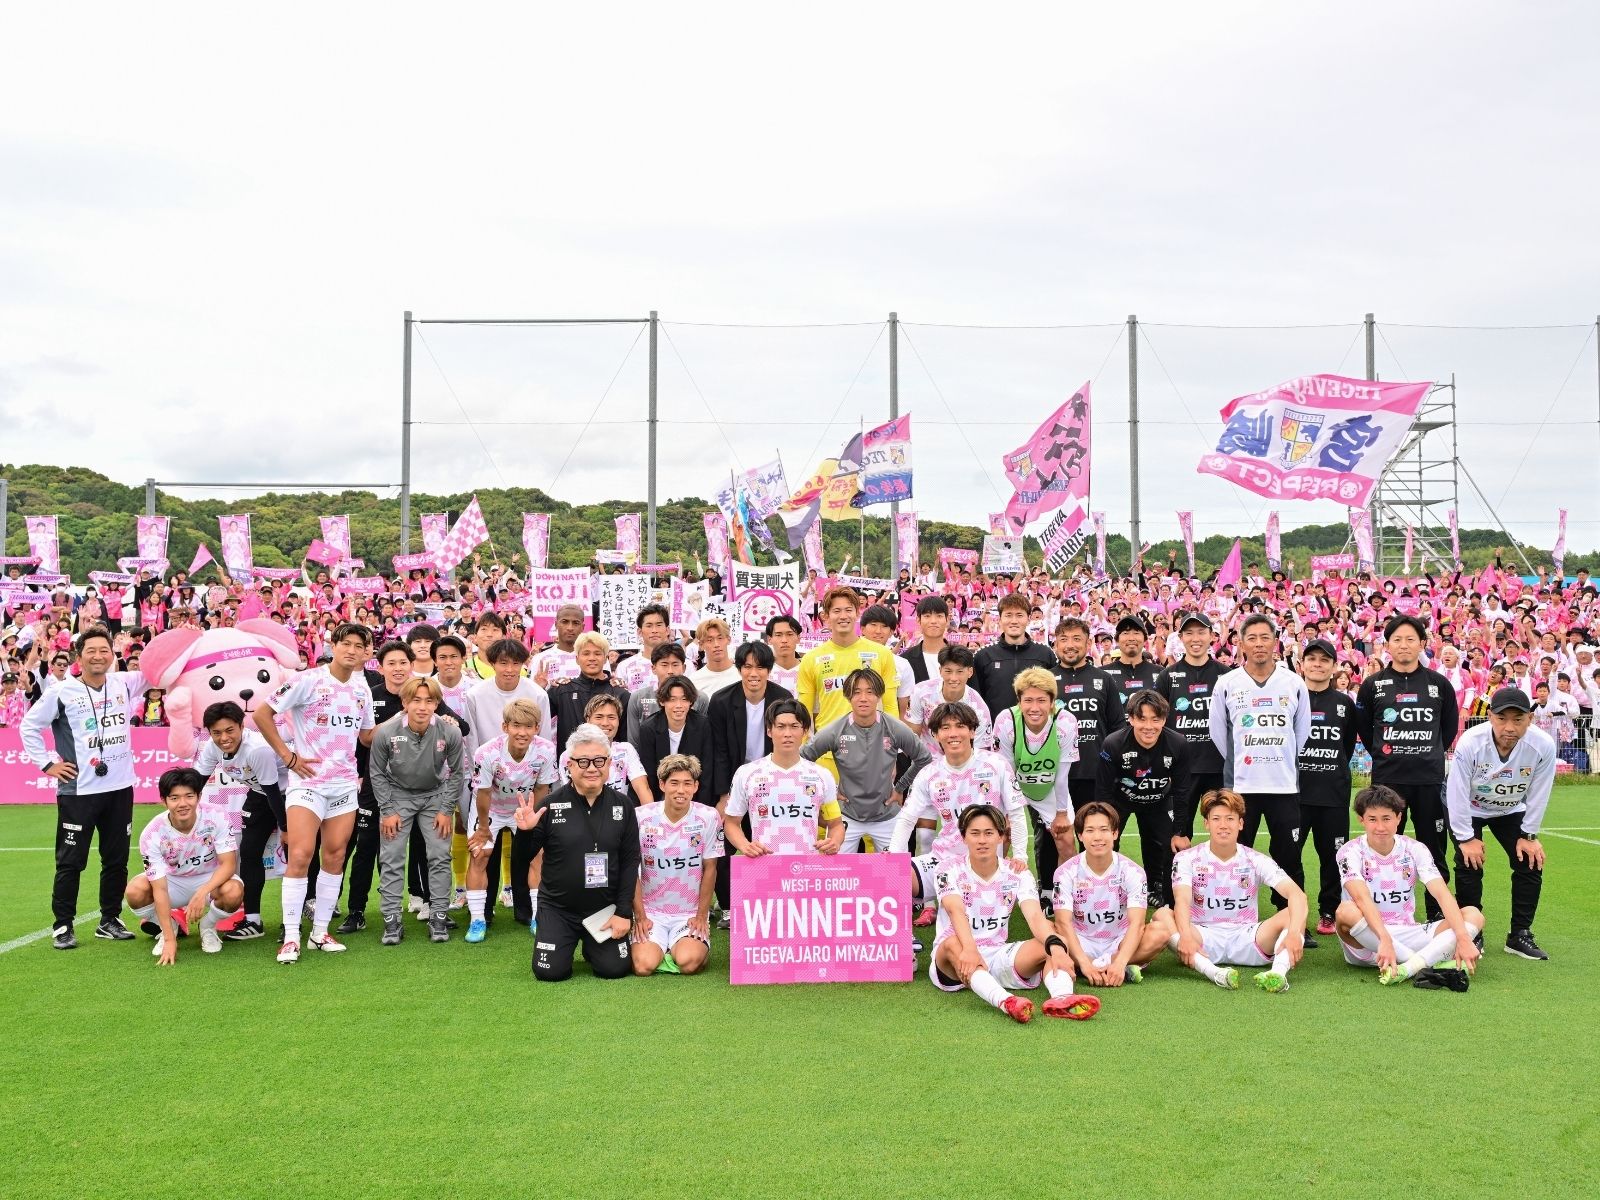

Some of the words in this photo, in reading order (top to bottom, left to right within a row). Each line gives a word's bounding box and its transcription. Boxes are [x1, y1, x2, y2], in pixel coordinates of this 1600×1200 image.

[1049, 528, 1085, 570] HEARTS
[736, 571, 794, 589] 質実剛犬
[536, 585, 588, 599] KOJI
[1068, 698, 1098, 711] GTS
[1192, 697, 1212, 711] GT
[101, 713, 126, 727] GTS
[1257, 714, 1286, 727] GTS
[1400, 707, 1434, 722] GTS
[1078, 720, 1097, 728] ATSU
[1176, 716, 1210, 728] UEMAT
[1310, 725, 1341, 740] GTS
[1383, 726, 1433, 741] UEMATSU
[1244, 735, 1284, 746] UEMATSU
[1298, 747, 1339, 758] EMATSU
[1138, 777, 1168, 789] GTS
[1495, 783, 1526, 795] GTS
[771, 804, 815, 818] いちご
[657, 853, 701, 869] いちご
[781, 878, 822, 892] WEST-B
[824, 877, 860, 891] GROUP
[1373, 886, 1412, 903] いちご
[1207, 895, 1250, 911] いちご
[743, 896, 898, 939] WINNERS
[744, 945, 831, 964] TEGEVAJARO
[835, 943, 899, 962] MIYAZAKI
